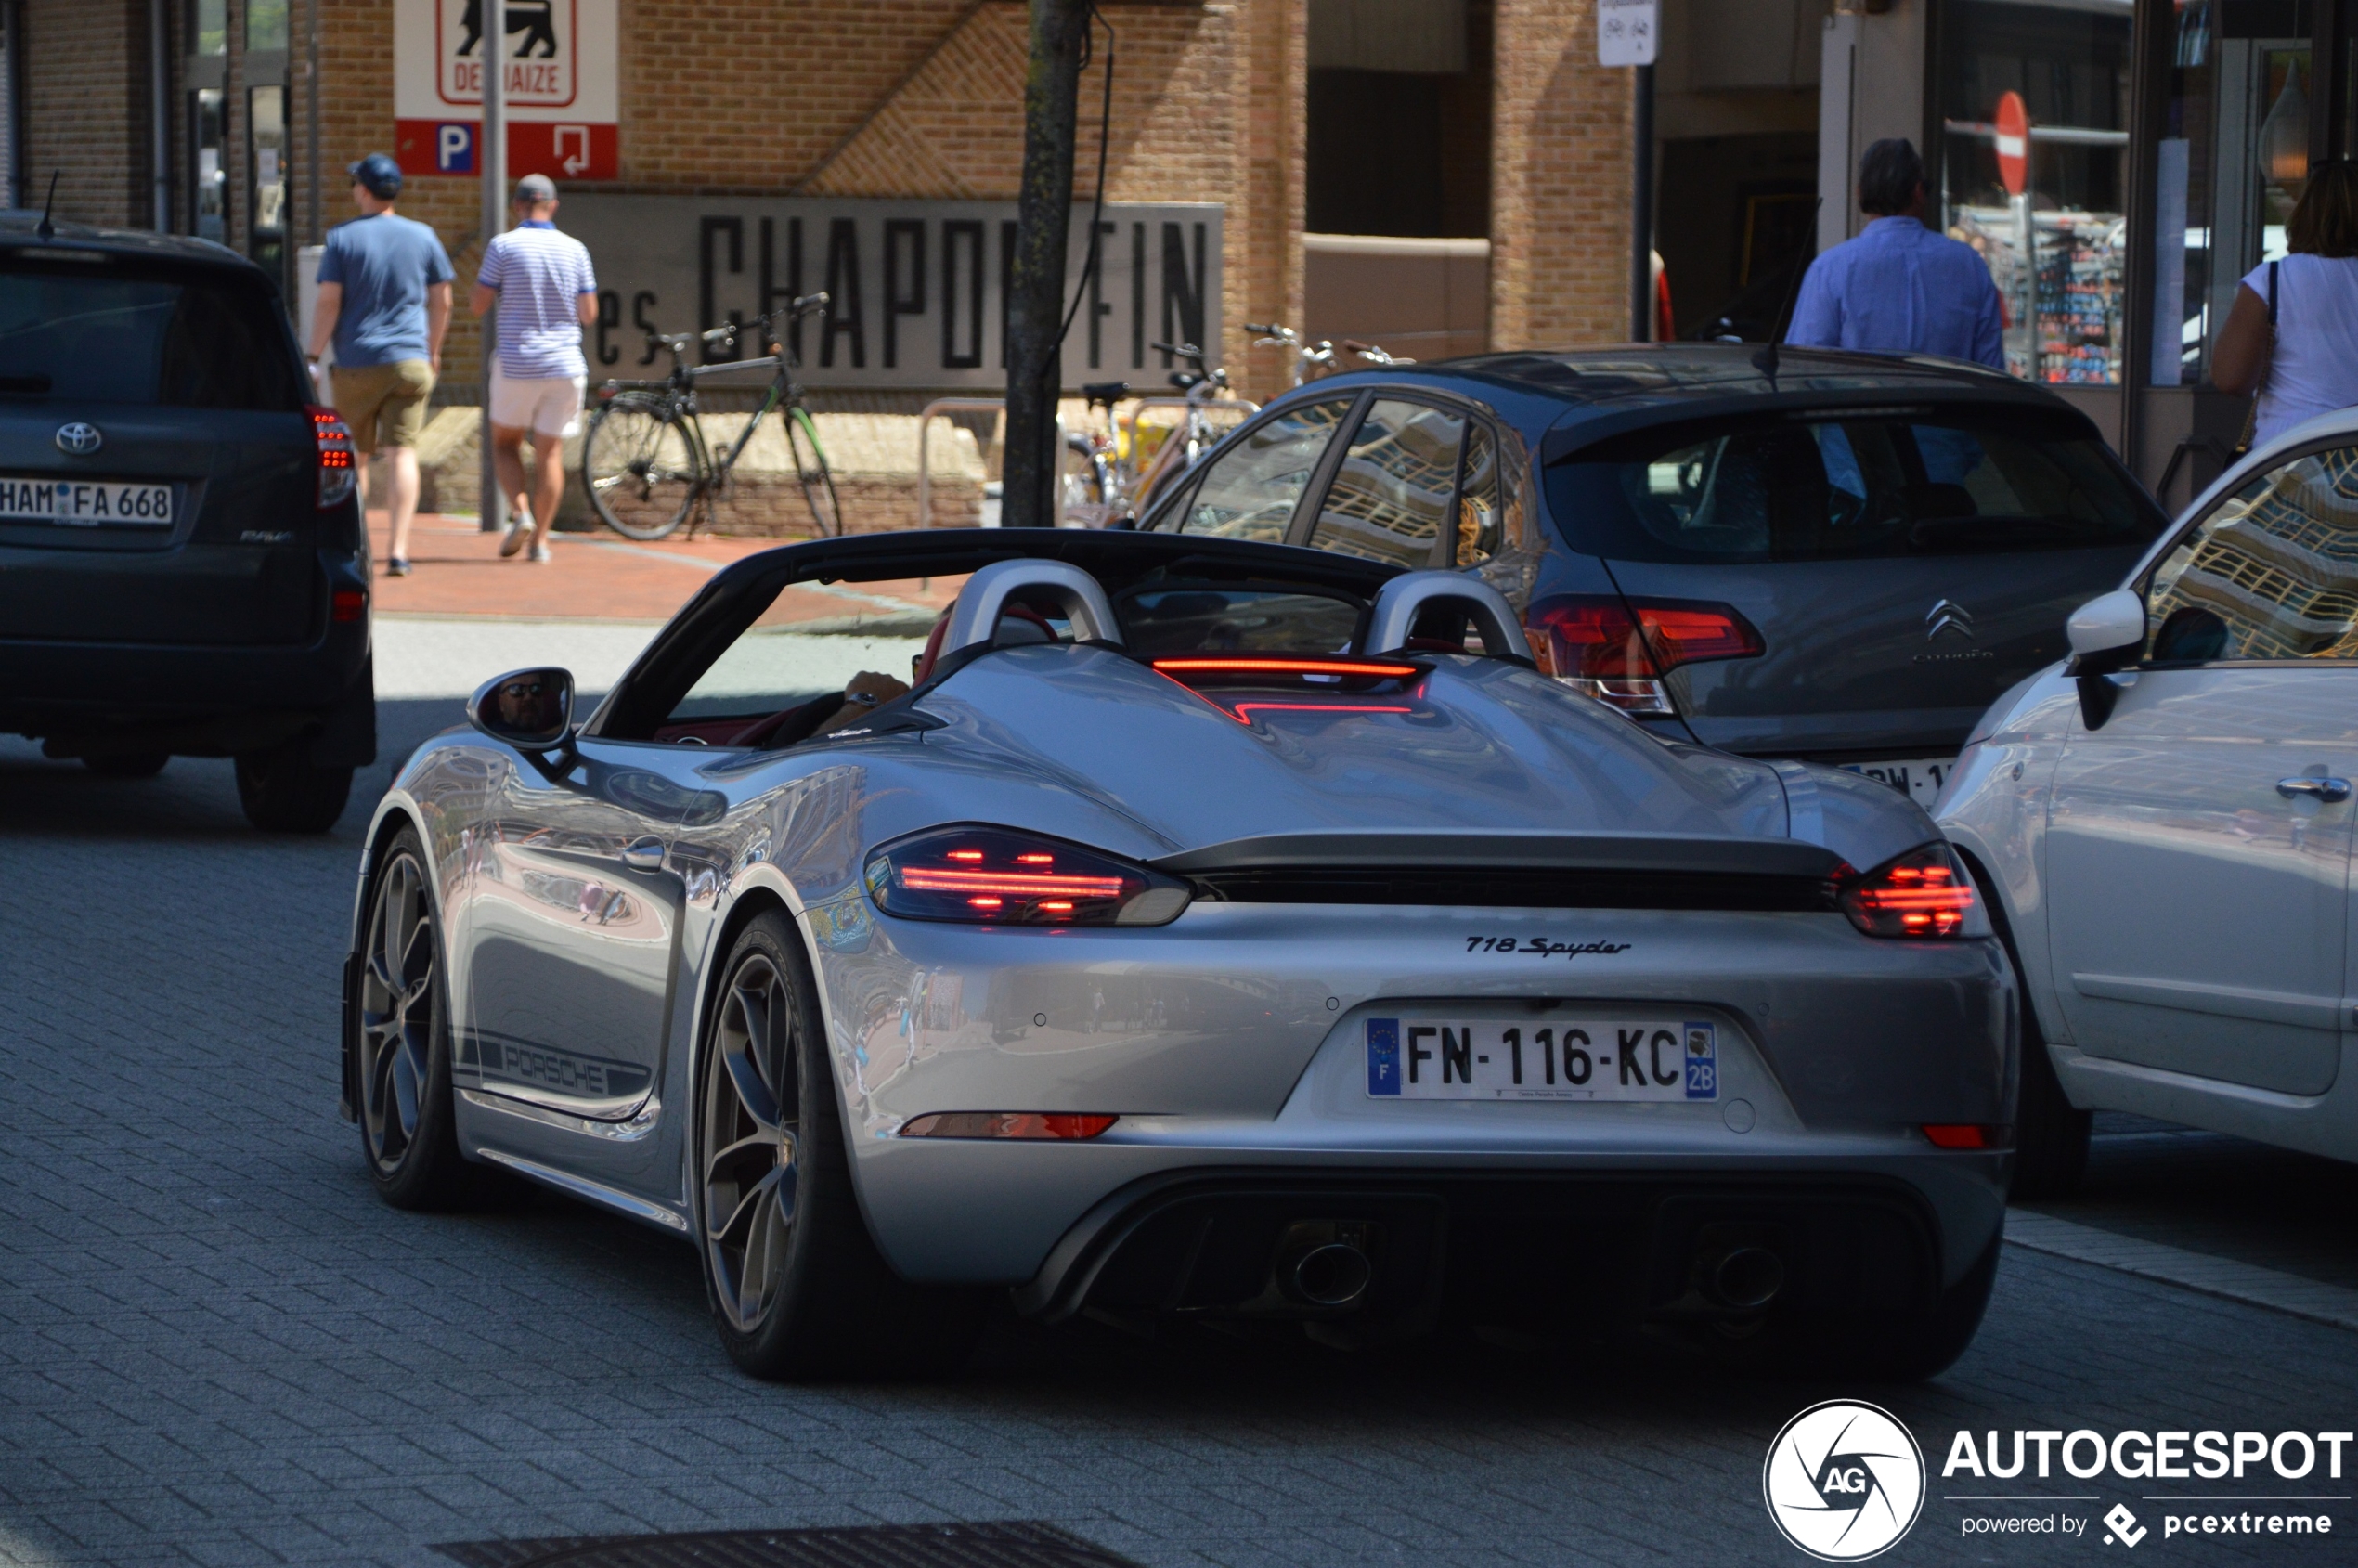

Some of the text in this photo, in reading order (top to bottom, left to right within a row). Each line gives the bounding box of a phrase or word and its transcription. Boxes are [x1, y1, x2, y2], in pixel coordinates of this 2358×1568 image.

[454, 62, 559, 92] DEAIZE
[439, 125, 470, 171] P
[597, 289, 656, 365] es
[1090, 221, 1205, 369] FIN
[0, 482, 168, 518] HAM FA 668
[1466, 936, 1631, 960] 718 Spyder
[505, 1045, 603, 1094] PORSCHE
[1380, 1064, 1389, 1080] F
[1407, 1026, 1679, 1087] FN-116-KC
[1688, 1064, 1714, 1091] 2B
